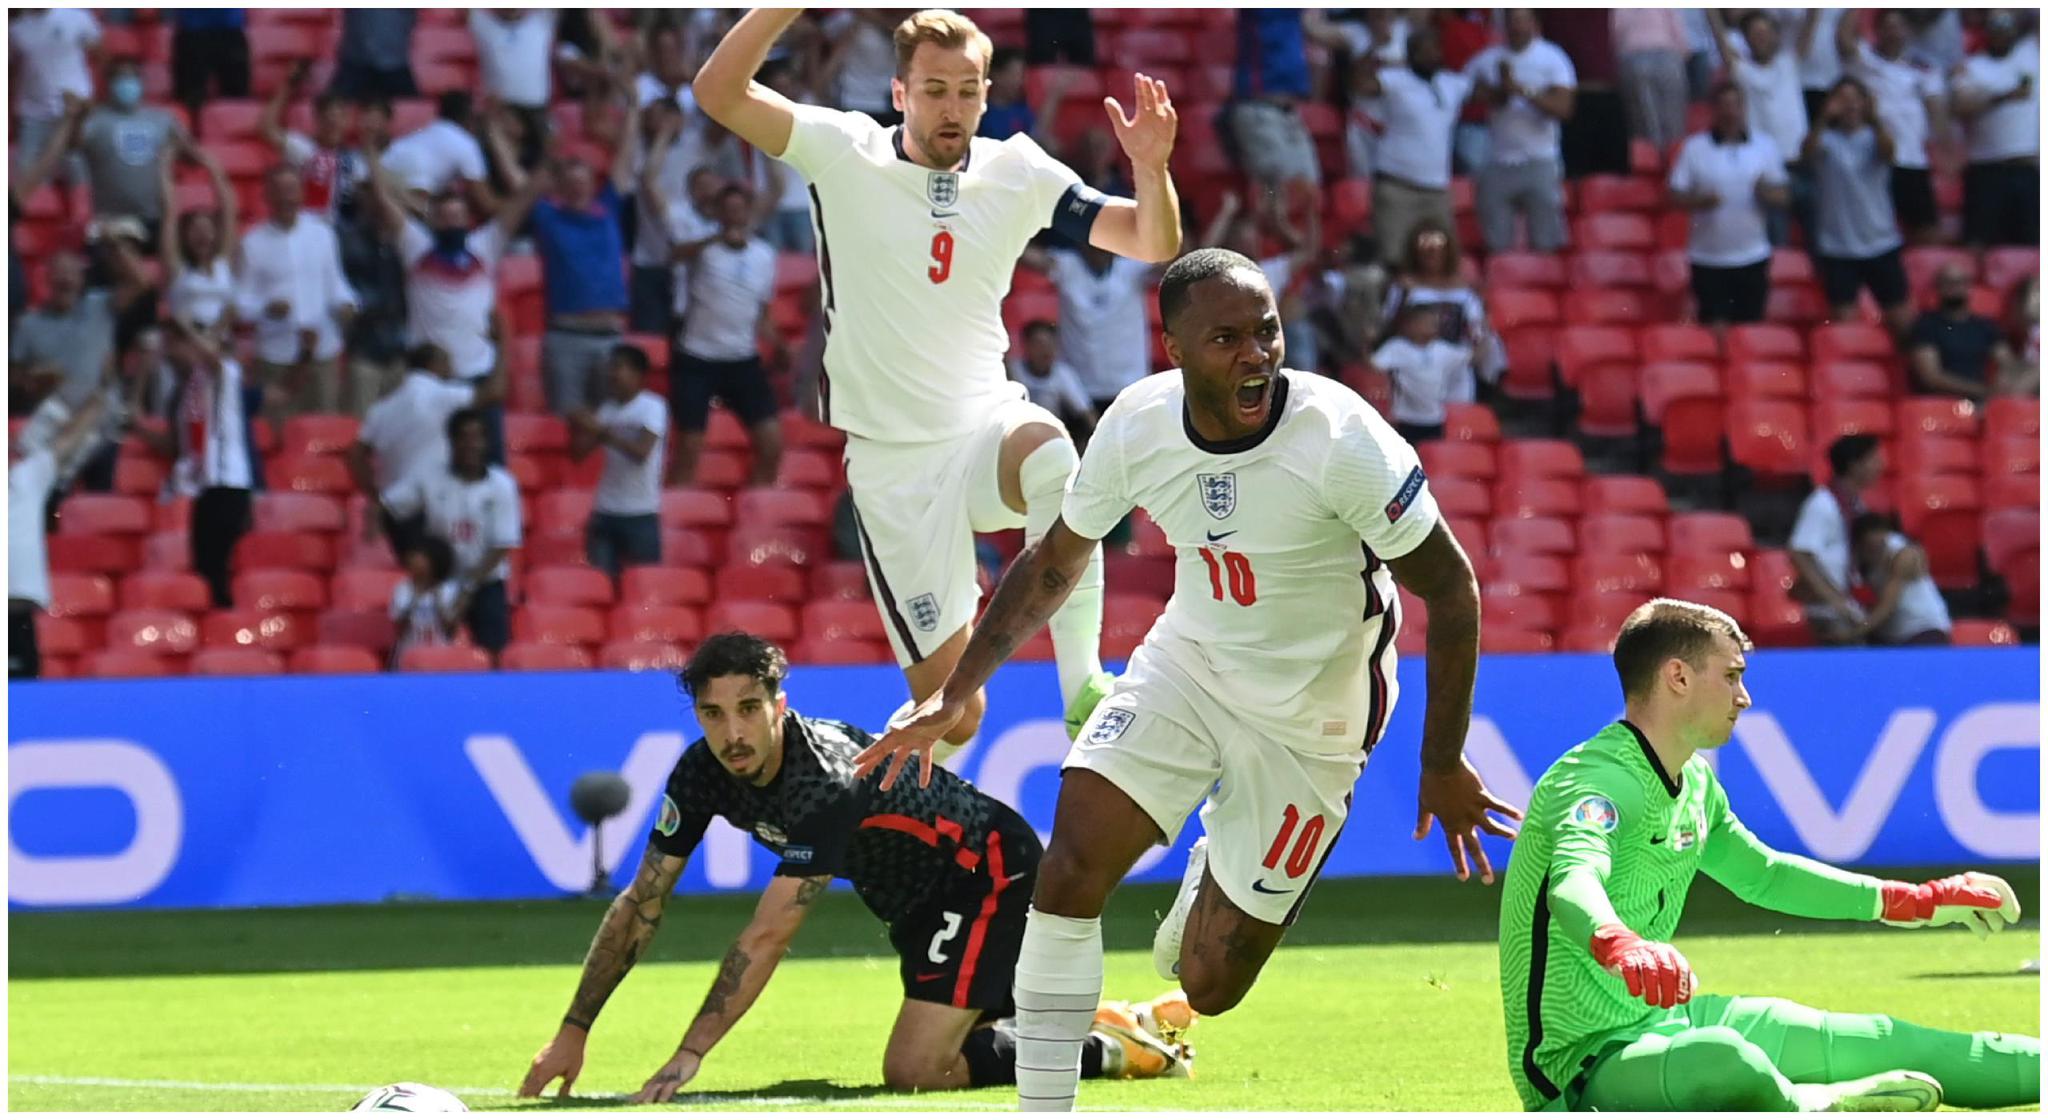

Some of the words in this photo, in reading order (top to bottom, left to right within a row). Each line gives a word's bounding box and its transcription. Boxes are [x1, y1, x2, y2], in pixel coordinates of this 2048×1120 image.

[928, 231, 954, 284] 9
[1198, 547, 1257, 607] 10
[783, 849, 814, 860] ESPECT
[1262, 803, 1325, 879] 10
[928, 911, 962, 964] 2
